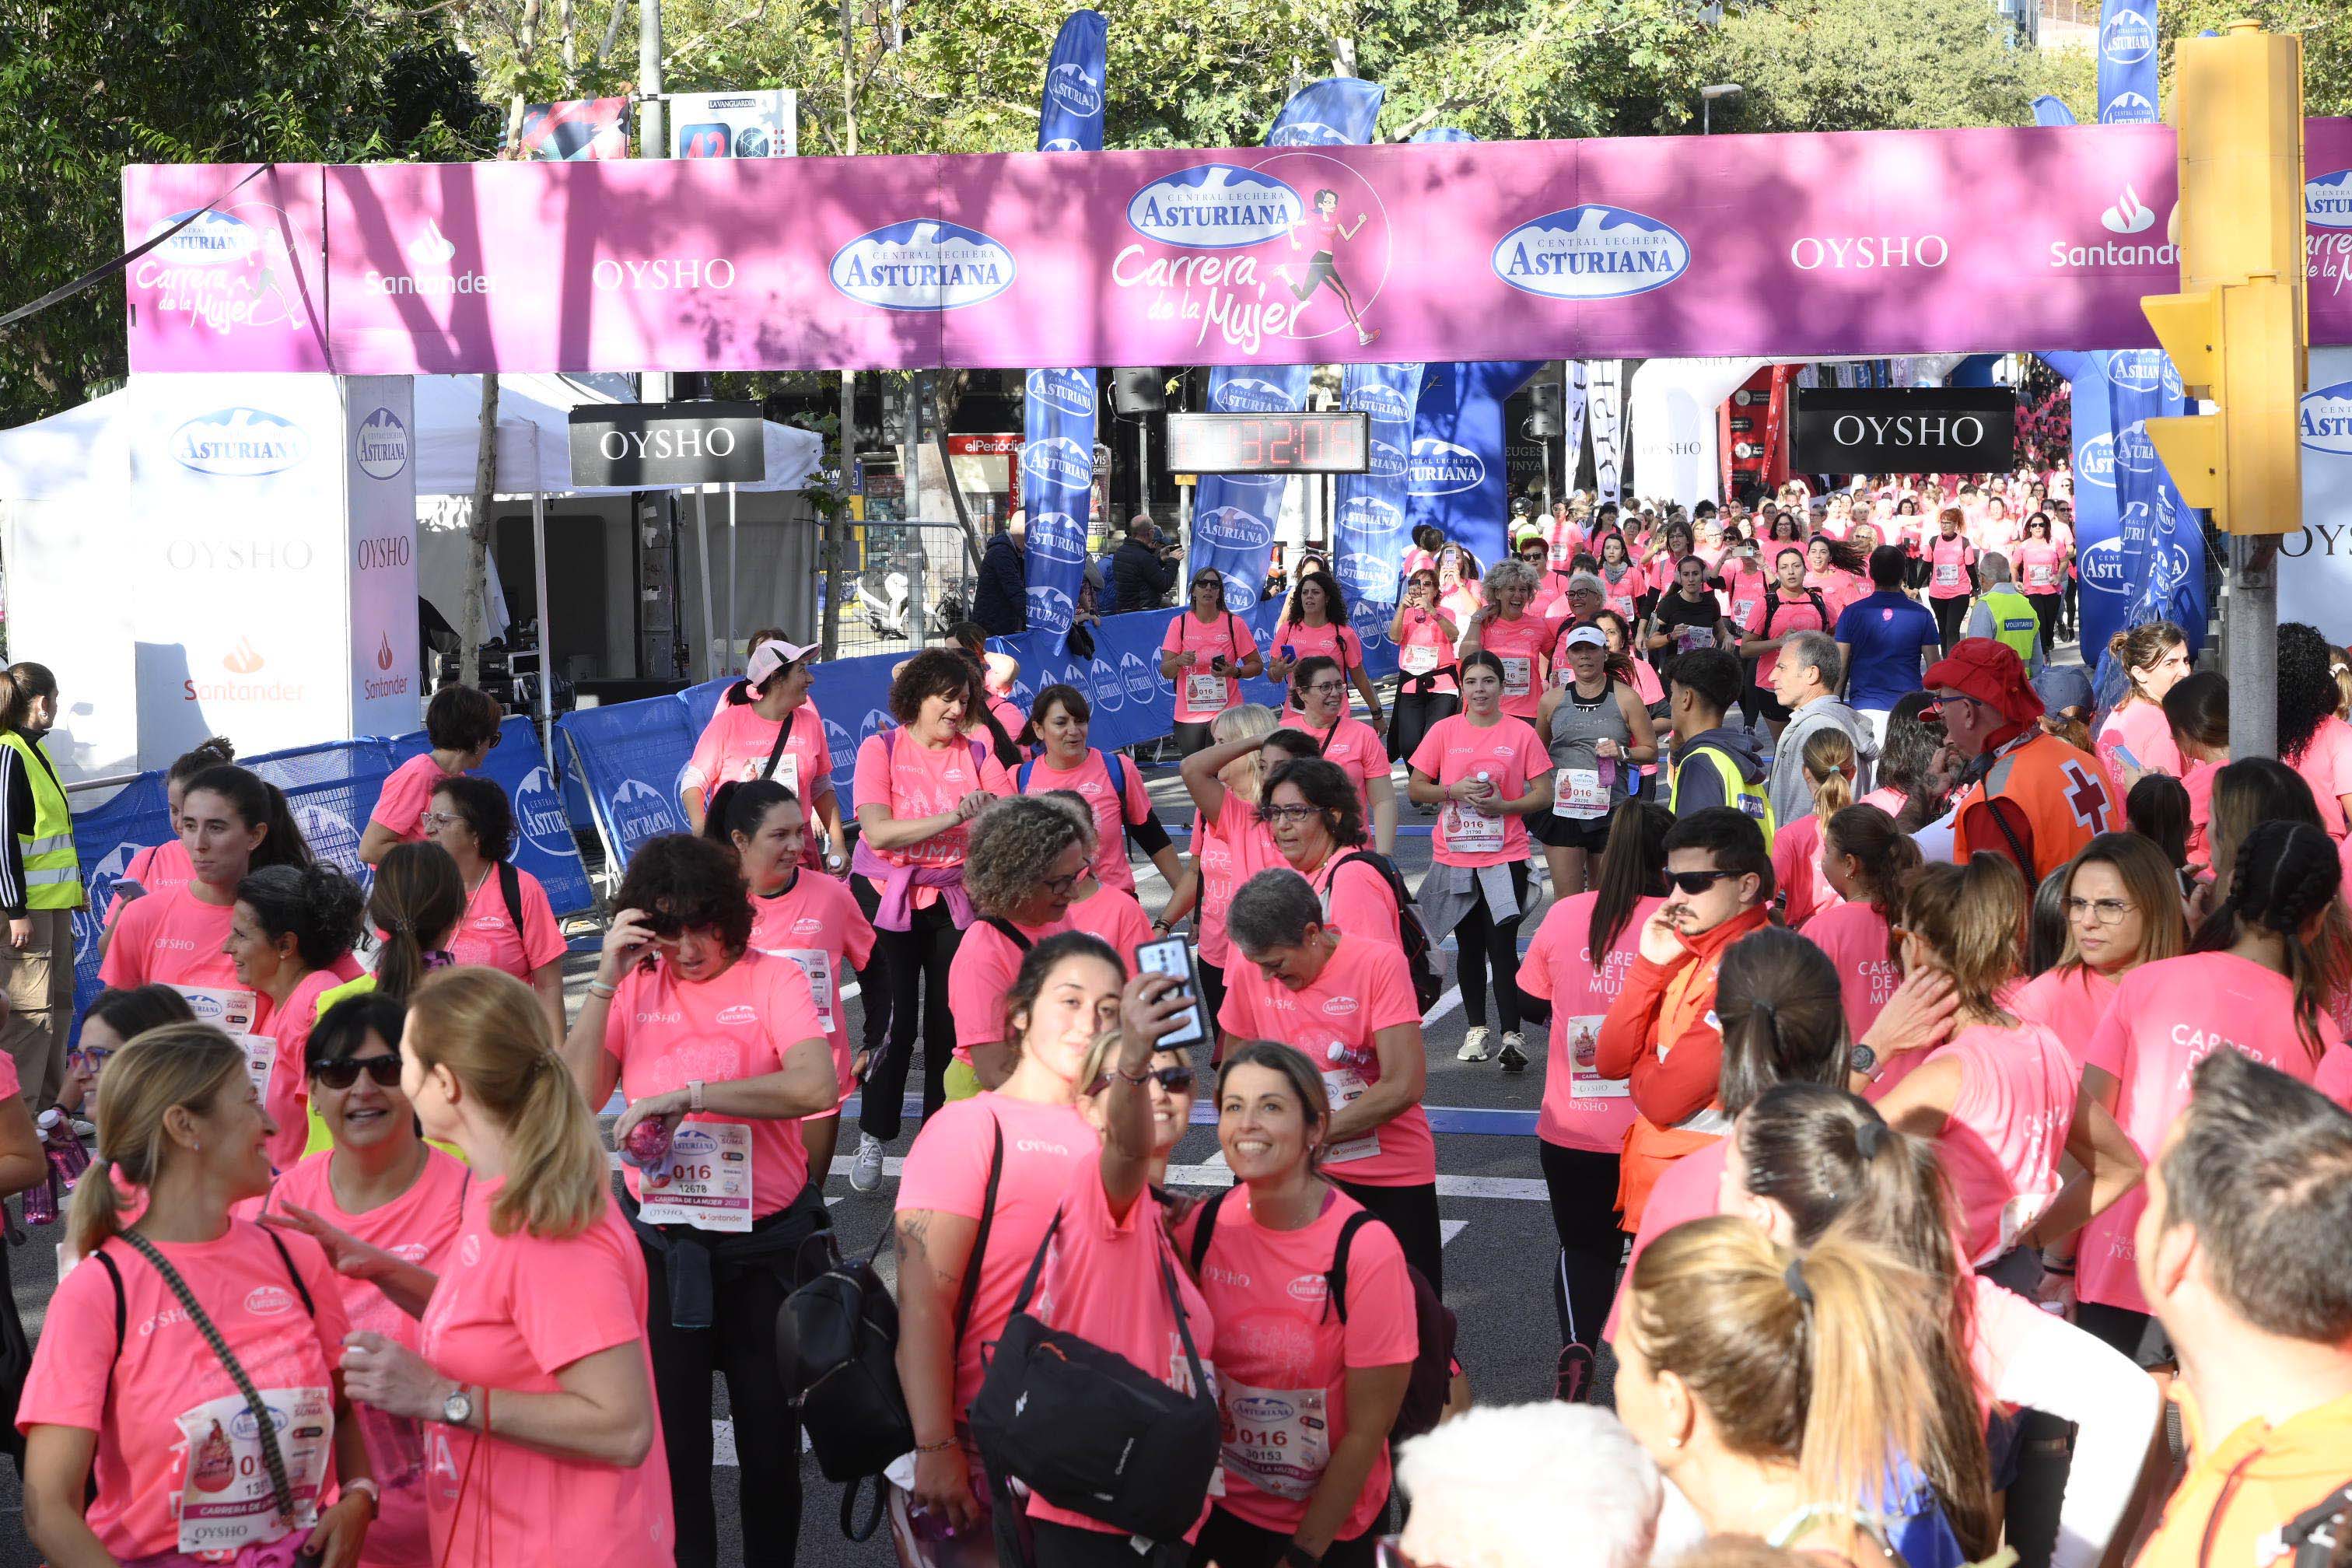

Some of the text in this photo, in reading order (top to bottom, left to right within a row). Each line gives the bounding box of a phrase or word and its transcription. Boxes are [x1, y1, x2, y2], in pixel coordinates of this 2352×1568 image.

[1167, 191, 1285, 201] CENTRAL LECHERA
[1140, 196, 1290, 227] ASTURIANA
[1536, 236, 1668, 249] CENTRAL LECHERA
[872, 250, 996, 261] CENTRAL LECHERA
[1507, 241, 1675, 276] ASTURIANA
[1790, 235, 1948, 270] OYSHO
[592, 257, 735, 290] OYSHO
[844, 253, 1003, 288] ASTURIANA
[1112, 244, 1258, 288] Carrera
[2323, 254, 2337, 278] la
[364, 270, 499, 295] Santander
[1147, 284, 1311, 355] de la Mujer
[1034, 375, 1091, 411] ASTURIANA
[1353, 394, 1412, 419] ASTURIANA
[1832, 415, 1986, 448] OYSHO
[359, 434, 405, 462] ASTURIANA
[599, 426, 736, 461] OYSHO
[1030, 449, 1090, 482] ASTURIANA
[1409, 466, 1478, 481] TURIANA
[1027, 525, 1085, 558] ASTURIANA
[166, 539, 313, 572] OYSHO
[357, 535, 409, 571] OYSHO
[1025, 604, 1071, 632] STURIANA
[2004, 620, 2035, 631] VOLUNTARIS
[184, 679, 304, 702] Santander
[365, 674, 408, 702] Santander
[1448, 747, 1475, 756] OYSHO
[894, 764, 926, 775] OYSHO
[1573, 788, 1592, 797] 016
[155, 936, 195, 952] OYSHO
[1592, 965, 1614, 980] DE
[1872, 975, 1892, 989] DE
[226, 1002, 248, 1010] SUMA
[1324, 1003, 1356, 1013] ASTURIANA
[636, 1011, 681, 1024] OYSHO
[718, 1012, 759, 1024] ASTURIANA
[1580, 1084, 1608, 1094] OYSHO
[1569, 1099, 1608, 1113] OYSHO
[672, 1141, 714, 1150] ASTURIANA
[721, 1137, 744, 1146] SUMA
[1017, 1138, 1069, 1157] OYSHO
[1340, 1143, 1373, 1156] Santander
[673, 1164, 712, 1180] 016
[680, 1184, 708, 1194] 12678
[654, 1195, 684, 1204] CARRERA
[650, 1208, 743, 1223] OYSHO Santander
[1206, 1265, 1251, 1289] OYSHO
[1237, 1403, 1290, 1417] ASTURIANA
[1240, 1429, 1289, 1447] 016
[200, 1504, 248, 1517] CARRERA
[194, 1524, 249, 1539] OYSHO
